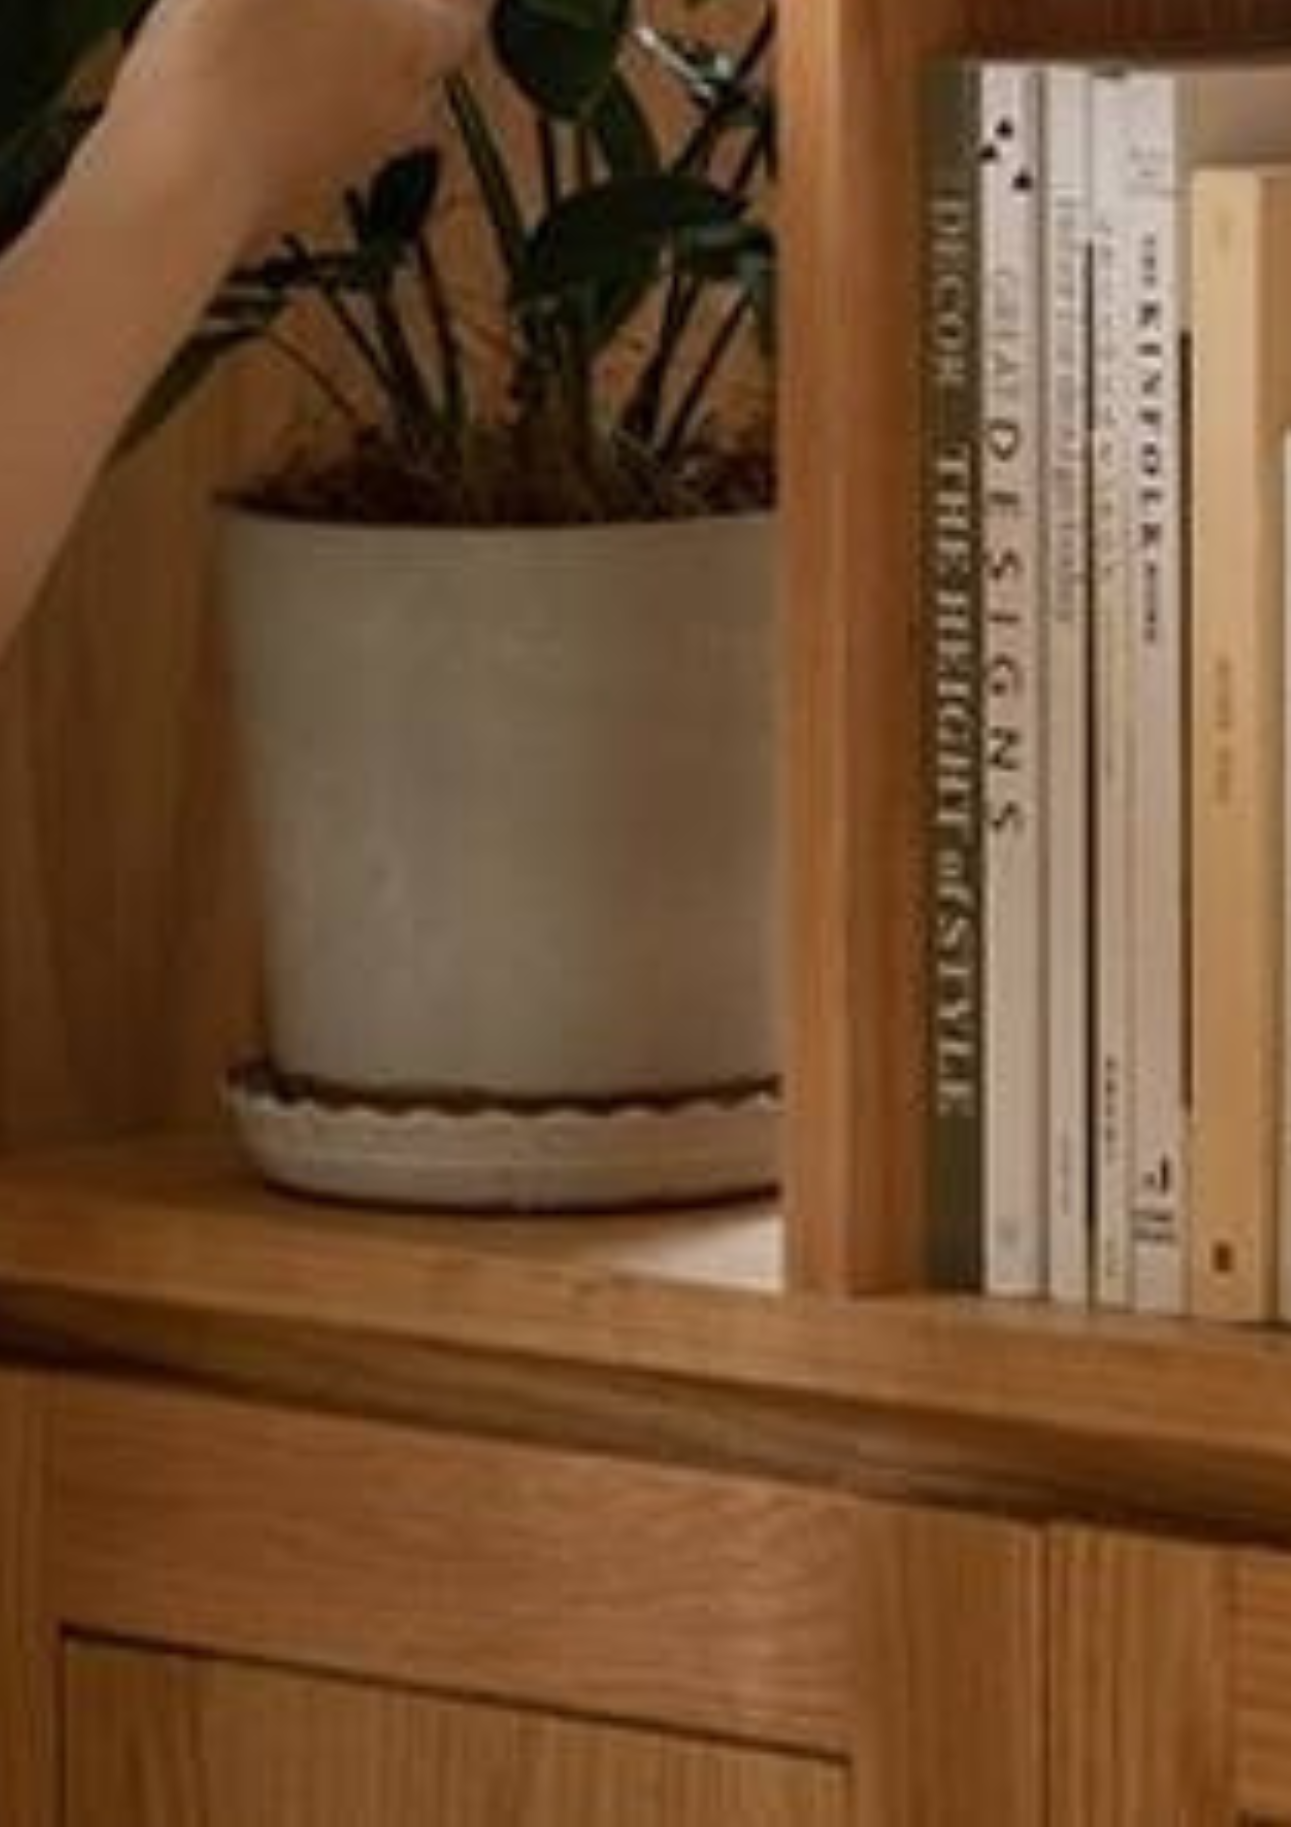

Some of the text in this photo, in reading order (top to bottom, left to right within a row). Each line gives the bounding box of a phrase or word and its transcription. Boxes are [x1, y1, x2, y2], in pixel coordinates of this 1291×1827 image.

[985, 419, 1025, 836] DESIGNS
[1138, 300, 1165, 550] KINFOLK
[931, 196, 974, 1118] DECOR THE HEIGHT of STYLE
